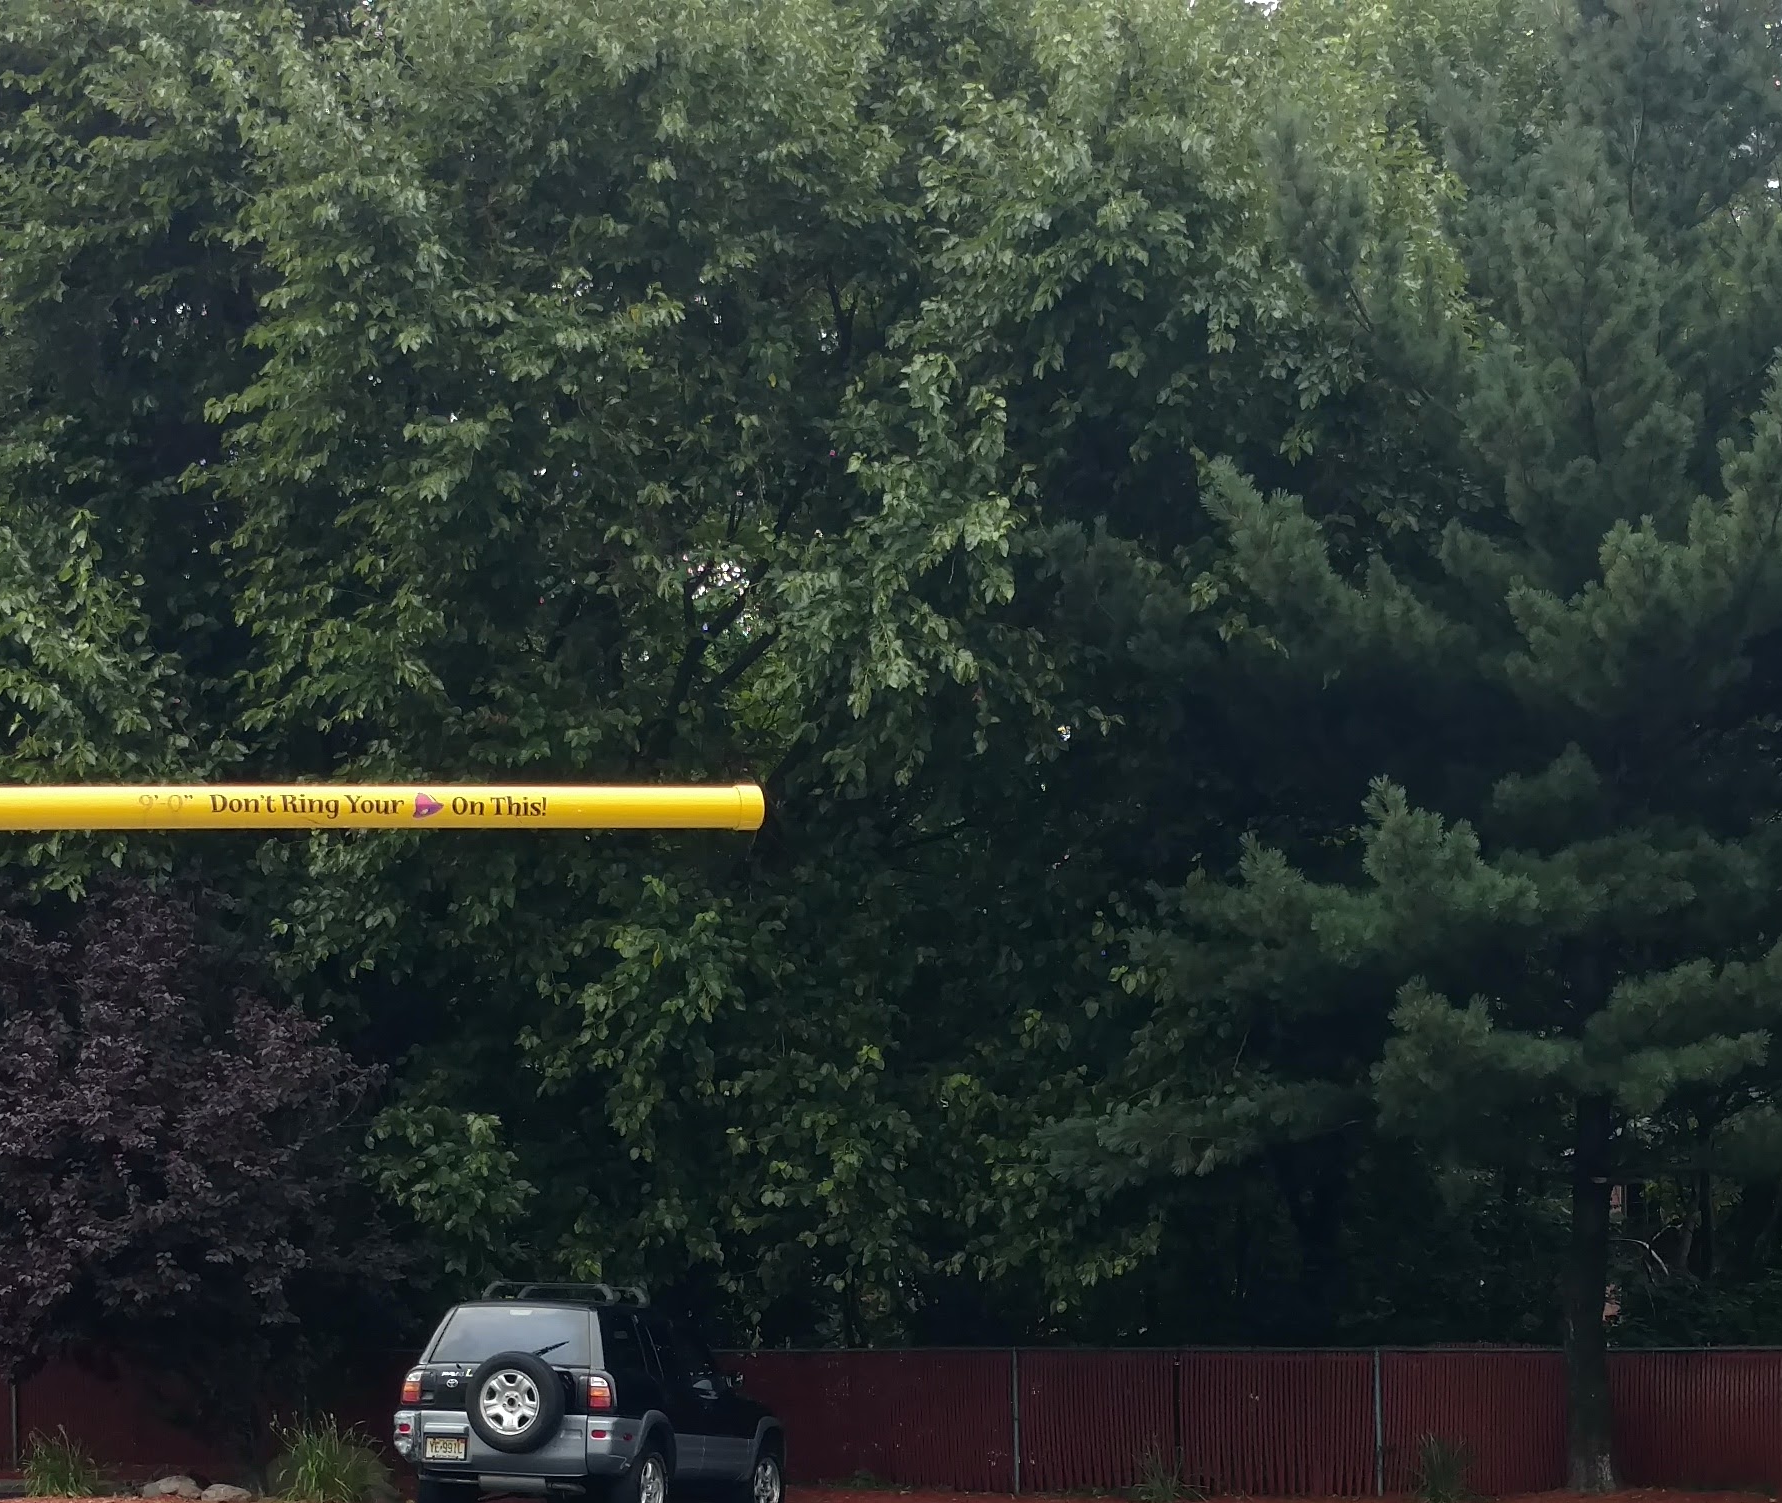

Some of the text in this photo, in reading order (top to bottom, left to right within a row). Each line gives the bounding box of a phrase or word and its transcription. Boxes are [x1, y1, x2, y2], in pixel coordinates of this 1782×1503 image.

[209, 793, 277, 813] Don't
[280, 793, 339, 820] Ring
[344, 794, 405, 815] Your
[451, 796, 485, 816] On
[490, 795, 548, 817] This!
